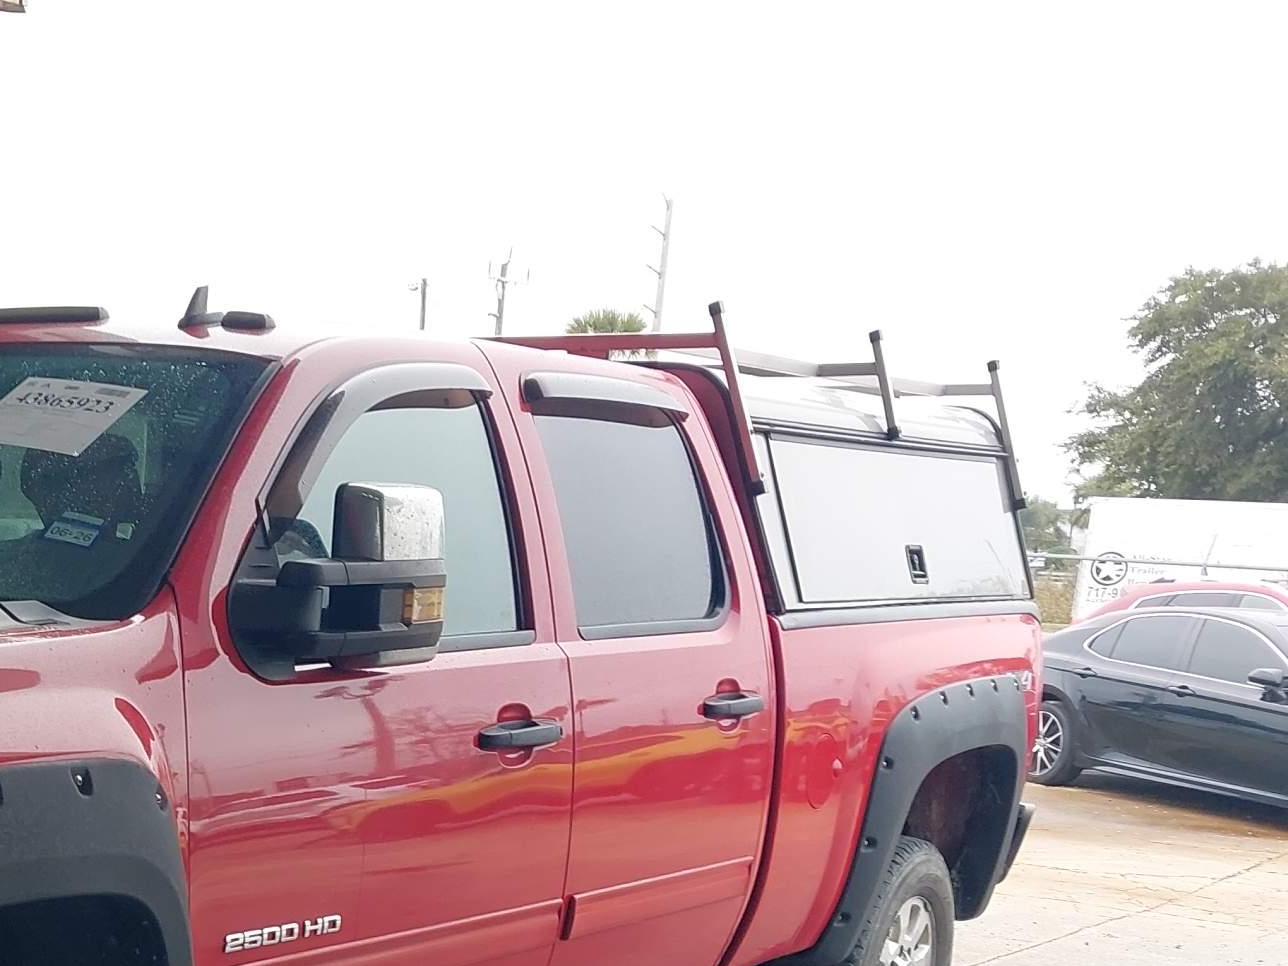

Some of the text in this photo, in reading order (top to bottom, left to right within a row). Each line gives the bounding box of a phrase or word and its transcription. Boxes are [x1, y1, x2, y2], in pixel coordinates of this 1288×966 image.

[16, 391, 114, 413] 43865923
[223, 914, 342, 953] 2500 HD
